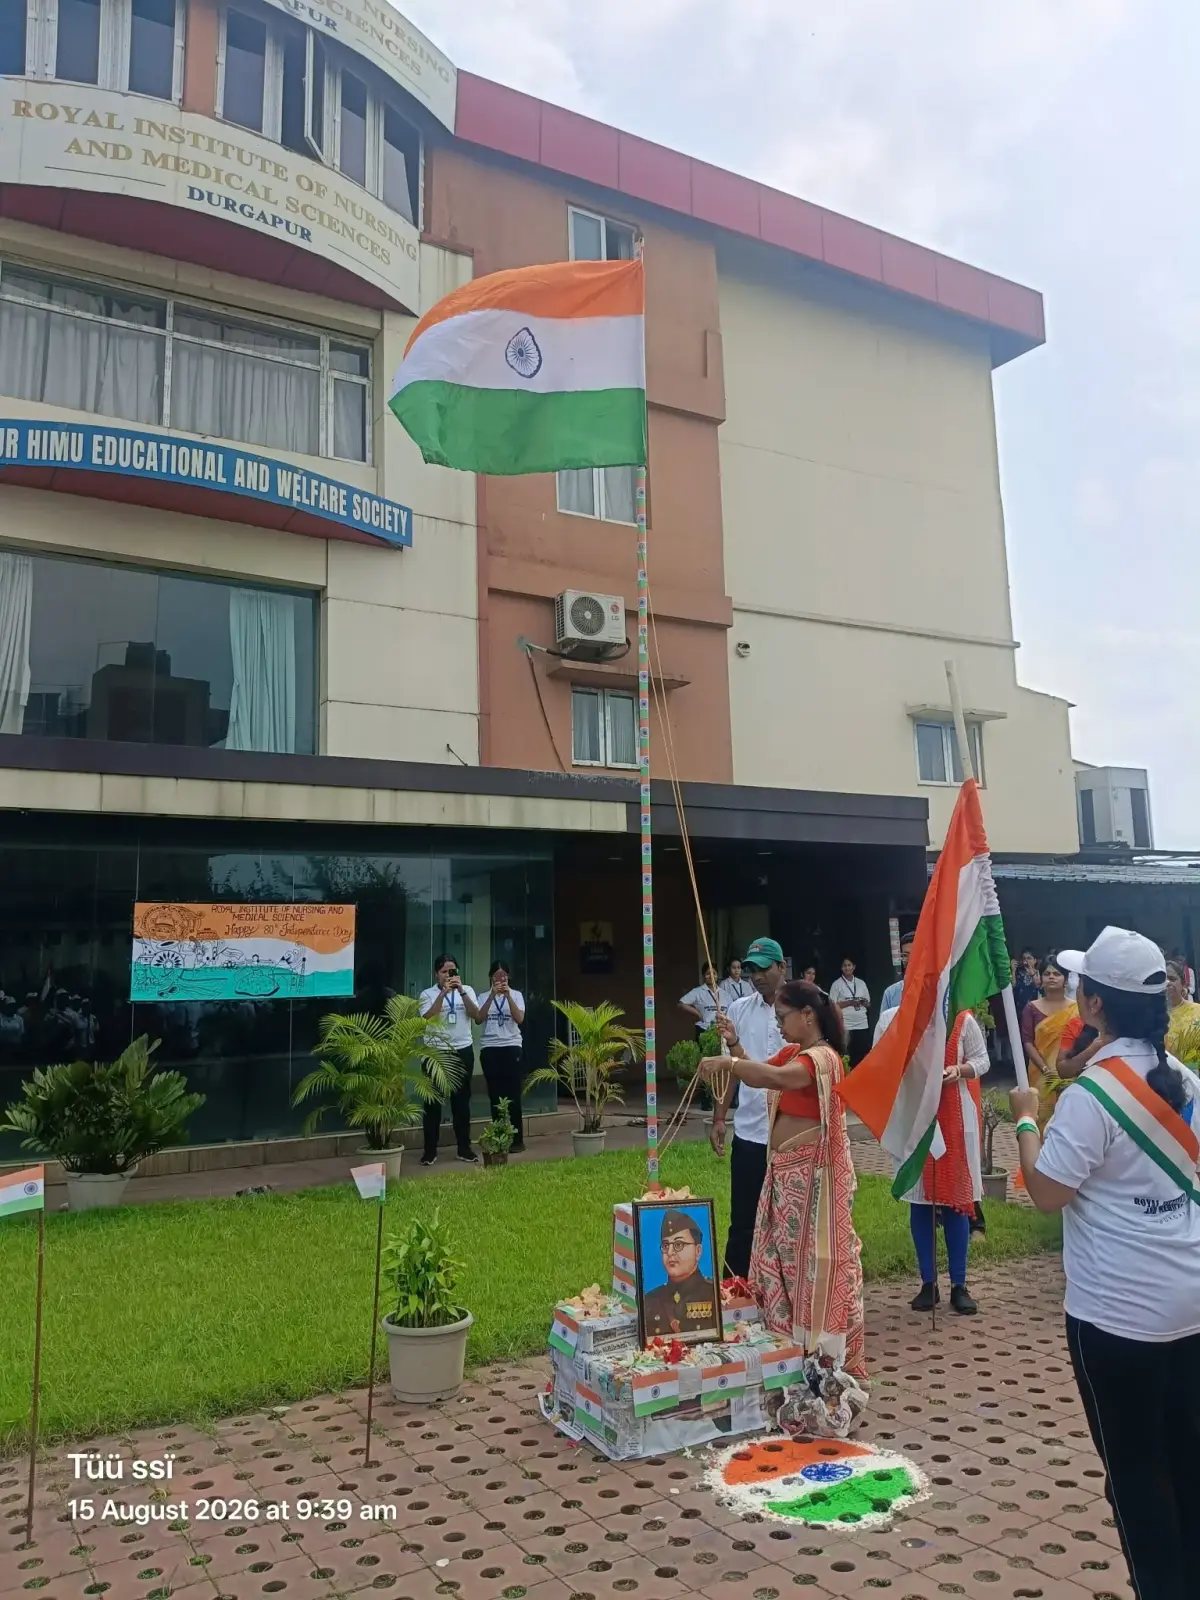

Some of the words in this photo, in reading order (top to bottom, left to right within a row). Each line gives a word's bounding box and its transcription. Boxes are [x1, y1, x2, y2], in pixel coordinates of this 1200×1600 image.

[12, 99, 125, 131] ROYAL
[133, 117, 289, 182] INSTITUTE
[296, 174, 328, 199] OF
[333, 191, 417, 261] NURSING
[64, 137, 133, 160] AND
[142, 148, 278, 206] MEDICAL
[285, 195, 391, 266] SCIENCES
[187, 185, 313, 243] DURGAPUR
[27, 429, 84, 463] HIMU
[92, 434, 227, 484] EDUCATIONAL
[234, 462, 270, 494] AND
[276, 468, 348, 517] WELFARE
[352, 493, 409, 538] SOCIETY
[211, 905, 235, 914] ROYAL
[239, 905, 279, 914] INSTITUTE
[281, 906, 291, 914] OF
[327, 906, 344, 914] AND
[224, 922, 260, 938] Happy
[333, 924, 352, 943] Day
[232, 913, 269, 921] MEDICAL
[272, 913, 305, 921] SCIENCE
